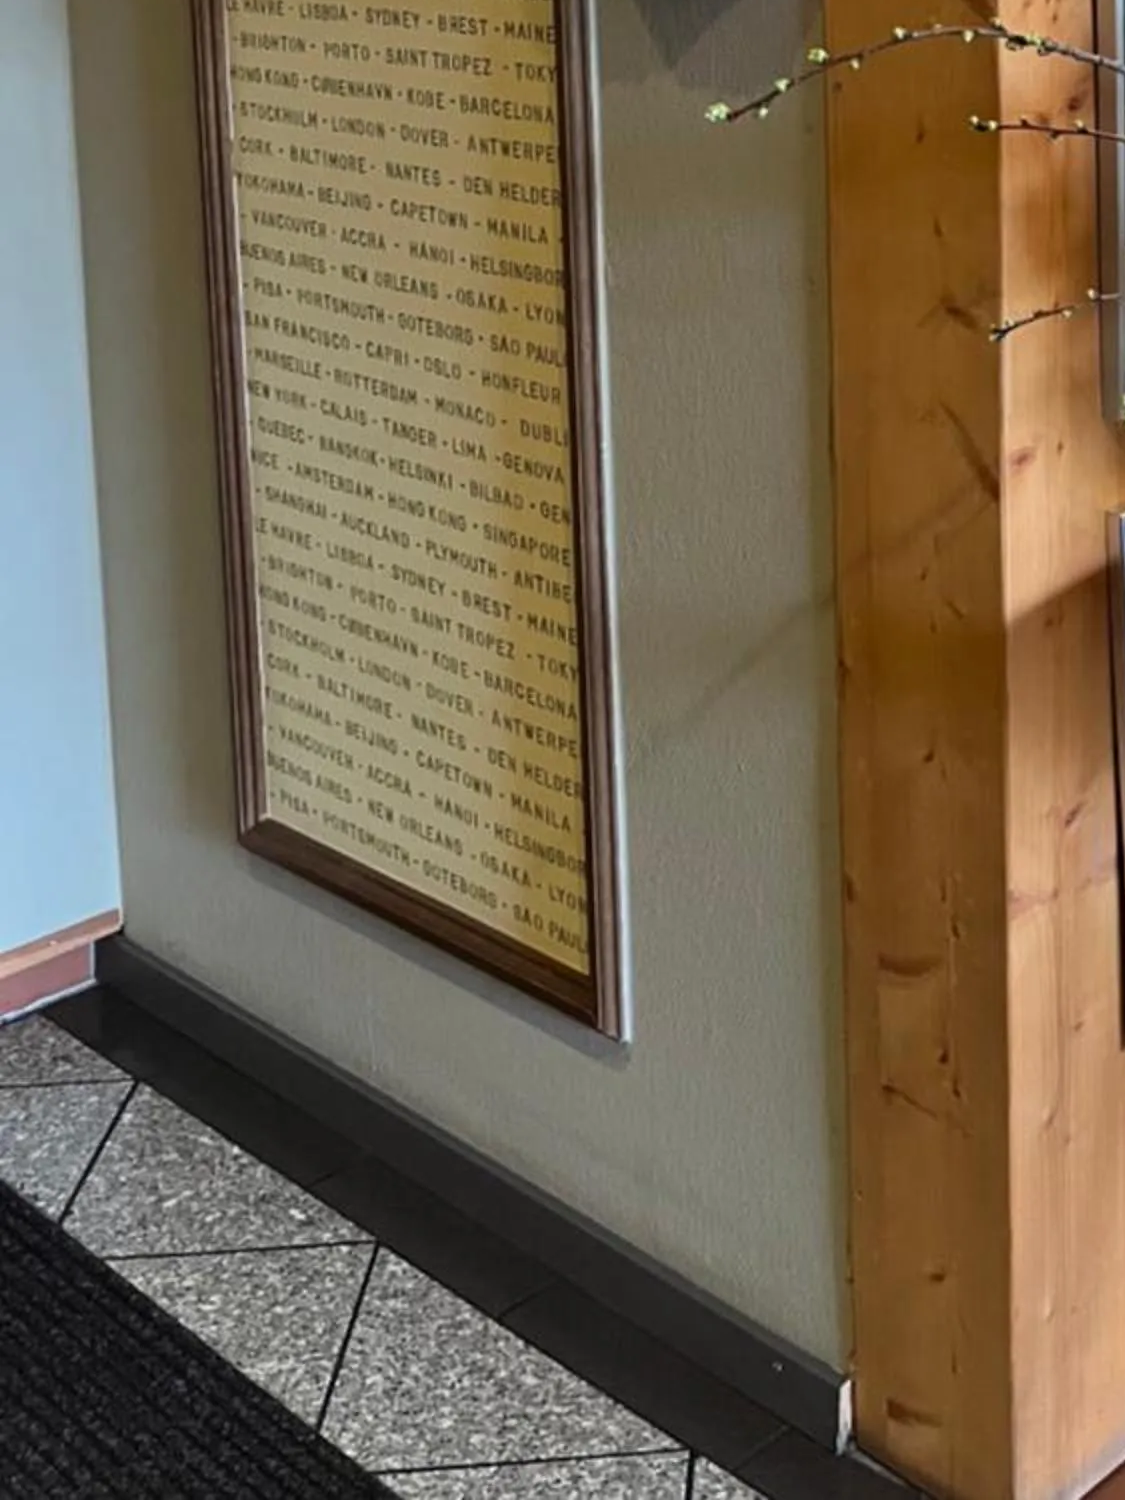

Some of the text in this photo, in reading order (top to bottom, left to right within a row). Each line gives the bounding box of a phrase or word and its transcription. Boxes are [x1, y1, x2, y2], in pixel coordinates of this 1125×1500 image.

[298, 1, 347, 23] LISBOA
[364, 6, 421, 29] SYDNEY
[437, 14, 487, 36] BREST
[504, 20, 554, 44] MAINE
[322, 40, 370, 62] PORTO
[384, 46, 428, 68] SAINT
[432, 51, 492, 76] TROPEZ
[264, 68, 554, 125] KONG KOBE BARCELONA
[330, 114, 386, 140] LONDON
[400, 124, 448, 148] DOVER
[288, 144, 366, 174] BALTIMORE
[385, 160, 442, 187] NANTES
[463, 174, 492, 196] DEN
[251, 208, 454, 266] VANCOUVER ACCRA HANOI
[317, 185, 548, 246] BEIJING CAPETOWN MANILA
[288, 251, 326, 275] AIRES
[374, 269, 438, 300] ORLEANS
[455, 286, 508, 315] OSAKA
[295, 287, 385, 324] PORTSMOUTH
[273, 316, 350, 352] FRANCISCO
[365, 340, 409, 368] CAPRI
[423, 354, 462, 381] OSLO
[480, 368, 562, 406] HONFLEUR
[333, 367, 418, 406] ROTTERDAM
[434, 395, 496, 429] MONACO
[320, 398, 367, 427] CALAIS
[382, 416, 437, 449] TANGER
[451, 436, 487, 464] LIMA
[502, 451, 565, 486] GENOVA
[317, 433, 377, 467] BANGKOK
[388, 454, 453, 491] HELSINKI
[469, 479, 524, 512] BILBAO
[424, 539, 498, 580] PLYMOUTH
[428, 504, 468, 534] KONG
[483, 522, 572, 567] SINGAPORE
[409, 604, 453, 636] SAINT
[456, 622, 515, 660] TROPEZ
[461, 588, 511, 622] BREST
[526, 611, 577, 646] MAINE
[425, 681, 473, 717] DOVER
[431, 649, 470, 680] KOBE
[483, 669, 577, 722] BARCELONA
[410, 712, 466, 752] NANTES
[487, 745, 516, 774] DEN
[415, 749, 493, 799] CAPETOWN
[510, 791, 571, 834] MANILA
[433, 793, 478, 829] HANOI
[479, 849, 532, 890] OSAKA
